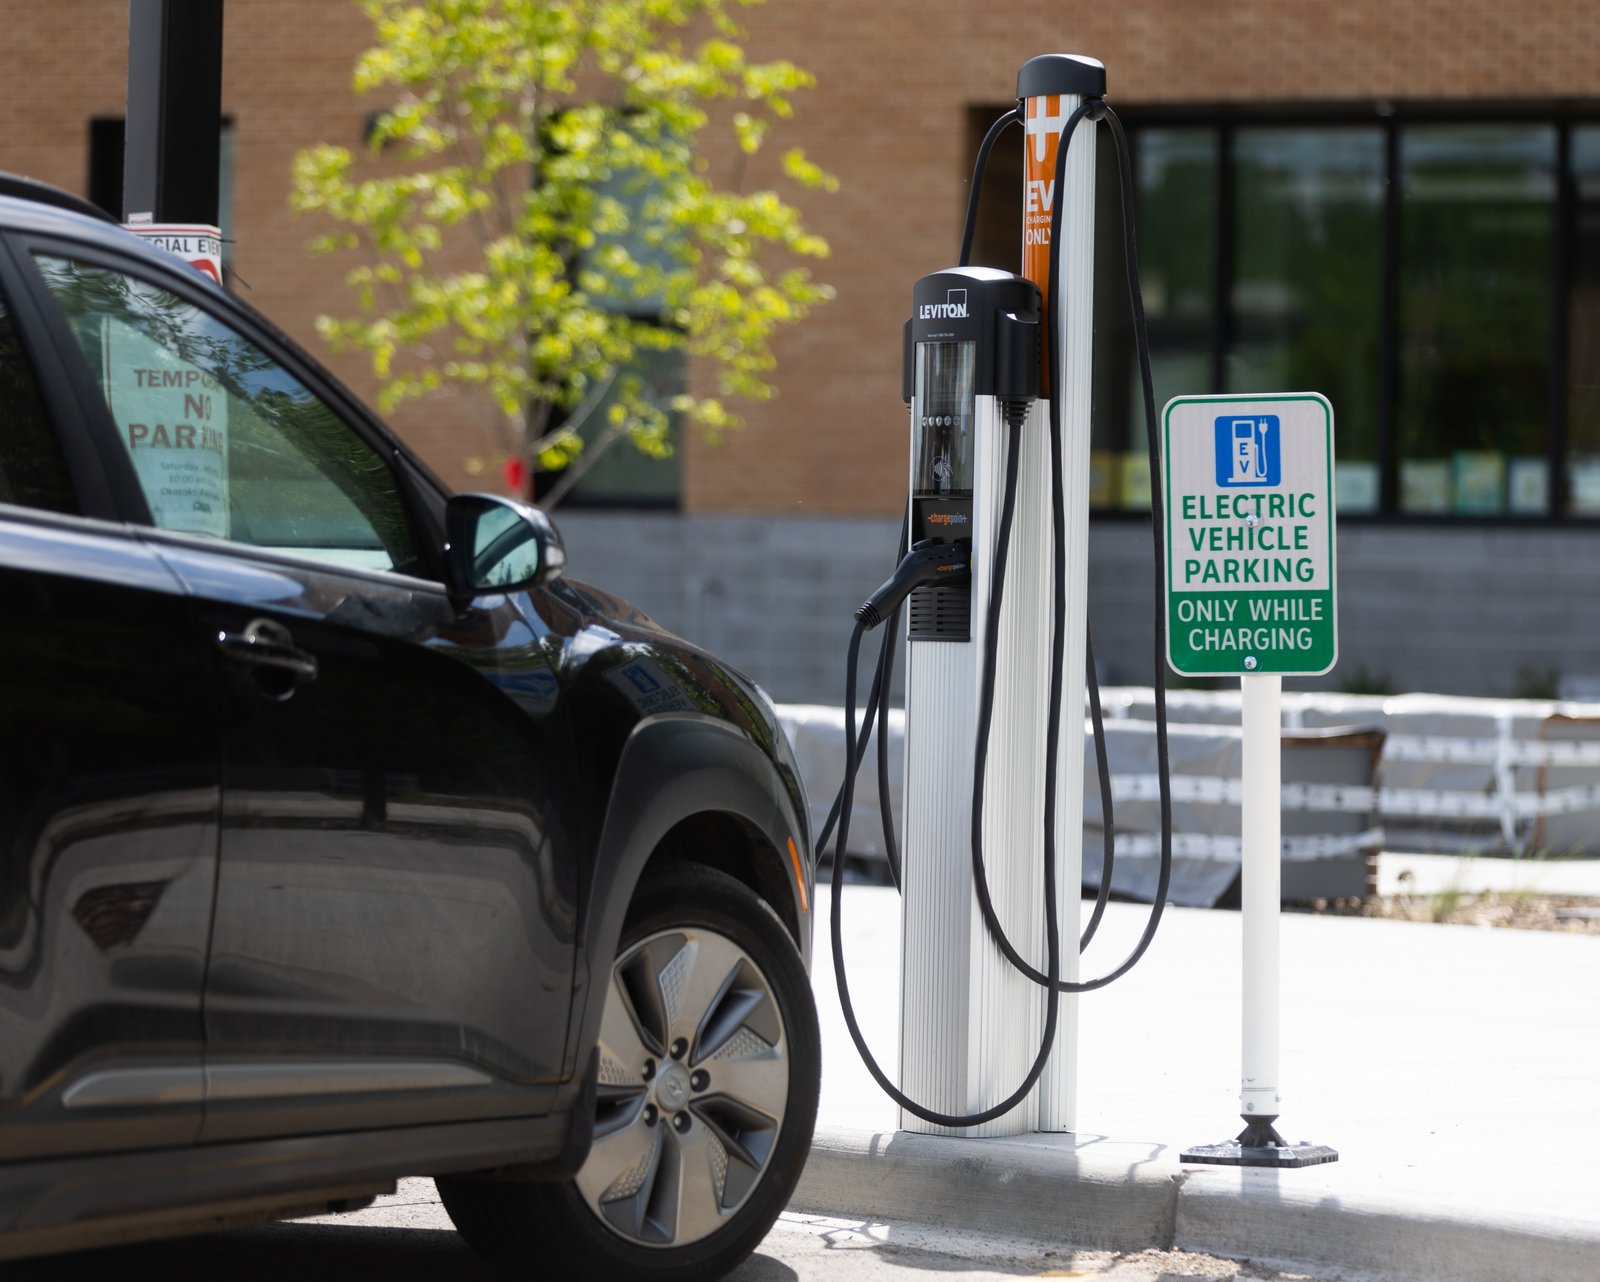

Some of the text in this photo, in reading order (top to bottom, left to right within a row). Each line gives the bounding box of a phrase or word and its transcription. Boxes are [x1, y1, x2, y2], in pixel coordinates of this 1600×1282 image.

[1027, 180, 1055, 212] EV
[1027, 215, 1052, 224] CHARGIN
[147, 238, 222, 256] CIAL EVEN
[920, 303, 967, 319] LEVITON
[184, 394, 212, 420] NO
[1182, 492, 1316, 520] ELECTRIC
[1189, 525, 1309, 551] VEHICLE
[1185, 558, 1314, 584] PARKING
[1177, 598, 1323, 622] ONLY WHILE
[1189, 627, 1313, 651] CHARGING
